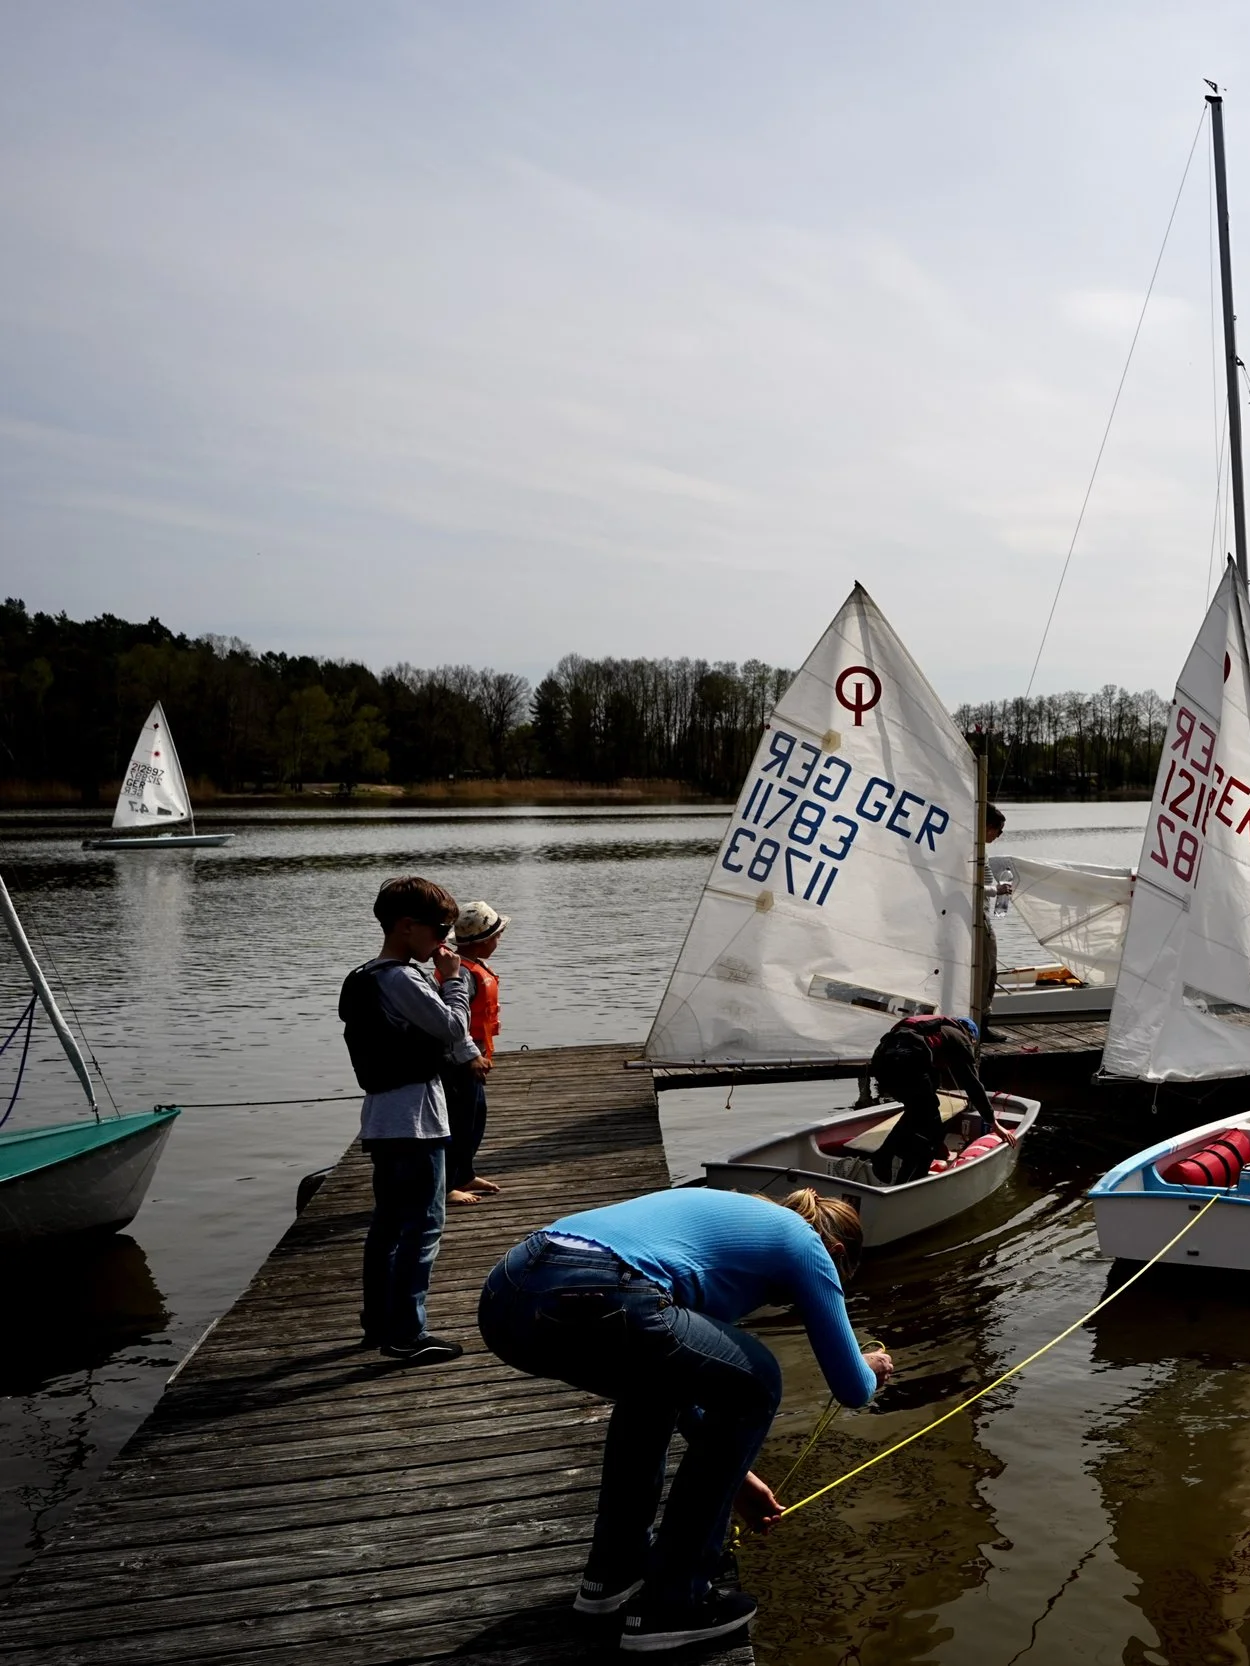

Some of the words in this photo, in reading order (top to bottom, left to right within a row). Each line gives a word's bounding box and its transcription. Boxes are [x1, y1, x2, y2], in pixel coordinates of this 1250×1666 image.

[126, 778, 146, 789] GER
[742, 778, 859, 861] 11783
[855, 777, 950, 852] GER
[581, 1578, 604, 1592] UMA
